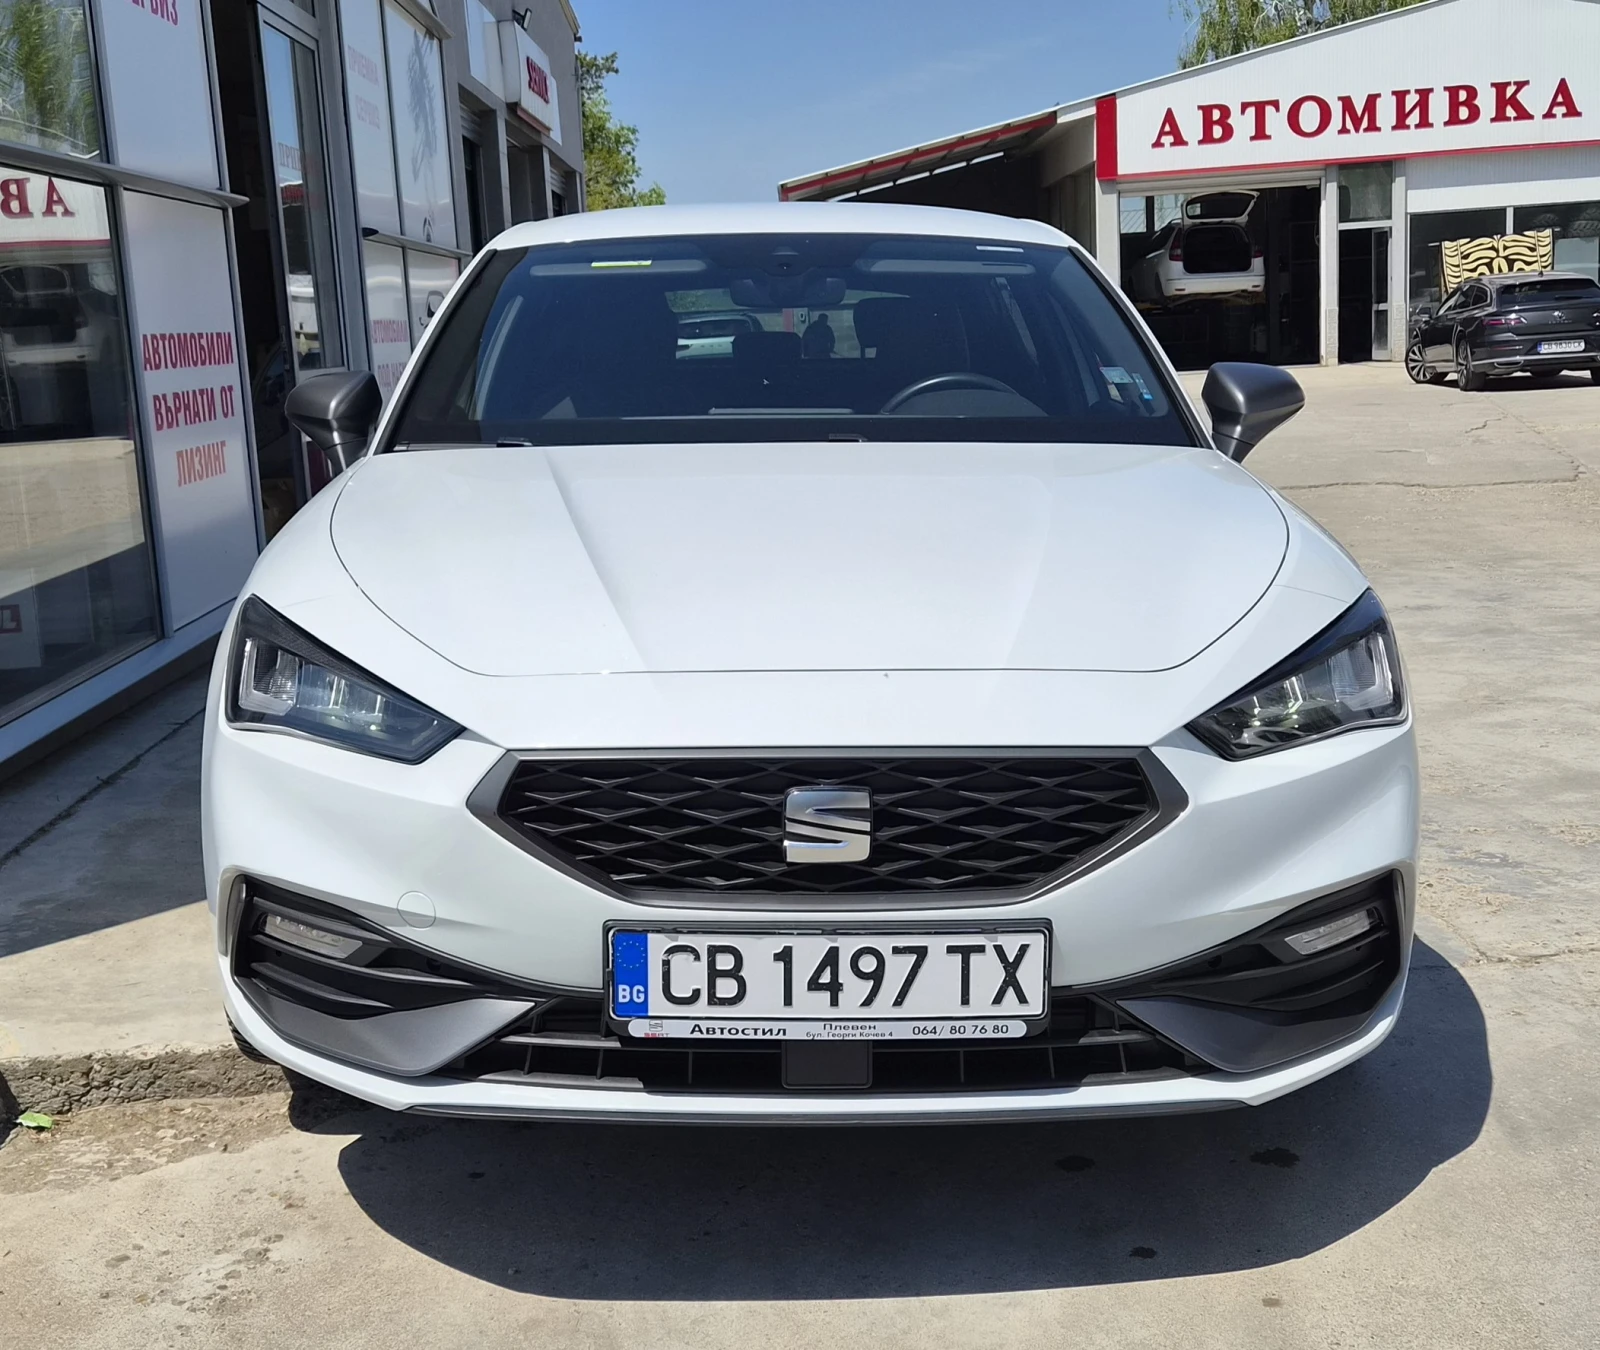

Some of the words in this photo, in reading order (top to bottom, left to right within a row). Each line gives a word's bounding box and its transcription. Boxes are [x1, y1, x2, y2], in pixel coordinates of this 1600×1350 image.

[1151, 77, 1583, 149] АВТОМИВКА
[142, 331, 234, 371] АВТОМОБИЛИ
[152, 387, 217, 432] ВЪРНАТИ
[220, 384, 235, 419] ОТ
[176, 440, 227, 487] ЛИЗИНГ
[661, 944, 747, 1007] CB
[773, 945, 929, 1007] 1497
[946, 943, 1031, 1006] TX
[618, 984, 645, 1003] BG
[689, 1023, 787, 1037] Автостил
[823, 1023, 877, 1031] Плевен
[827, 1031, 857, 1040] Георги
[912, 1025, 945, 1036] 064/
[949, 1025, 966, 1035] 80
[971, 1025, 987, 1035] 76
[992, 1024, 1009, 1034] 80
